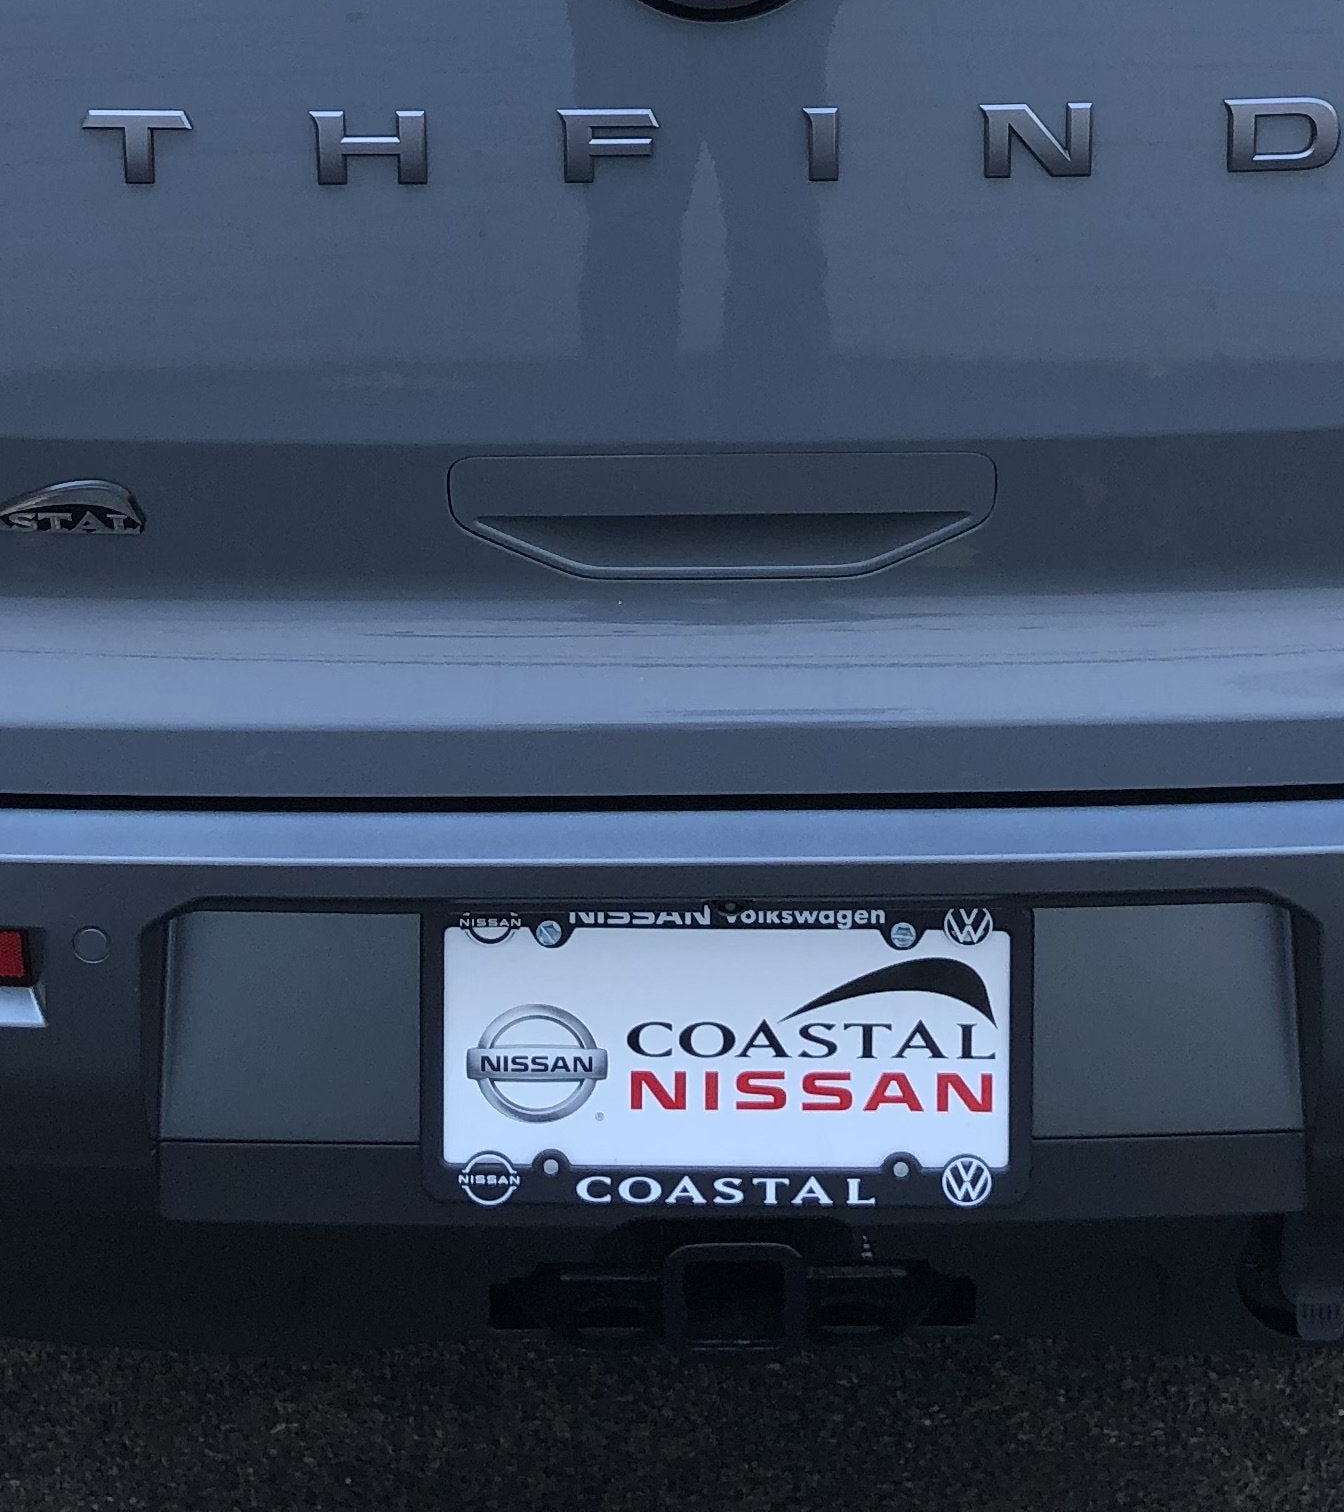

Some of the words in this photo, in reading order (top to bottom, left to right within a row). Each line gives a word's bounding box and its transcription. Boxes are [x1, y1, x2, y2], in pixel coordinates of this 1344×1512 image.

[459, 918, 522, 927] NISSAN
[569, 905, 711, 925] NISSAN
[626, 1020, 997, 1060] COASTAL
[480, 1055, 594, 1073] NISSAN
[630, 1070, 993, 1113] NISSAN
[458, 1174, 520, 1185] NISSAN
[575, 1175, 876, 1206] COASTAL
